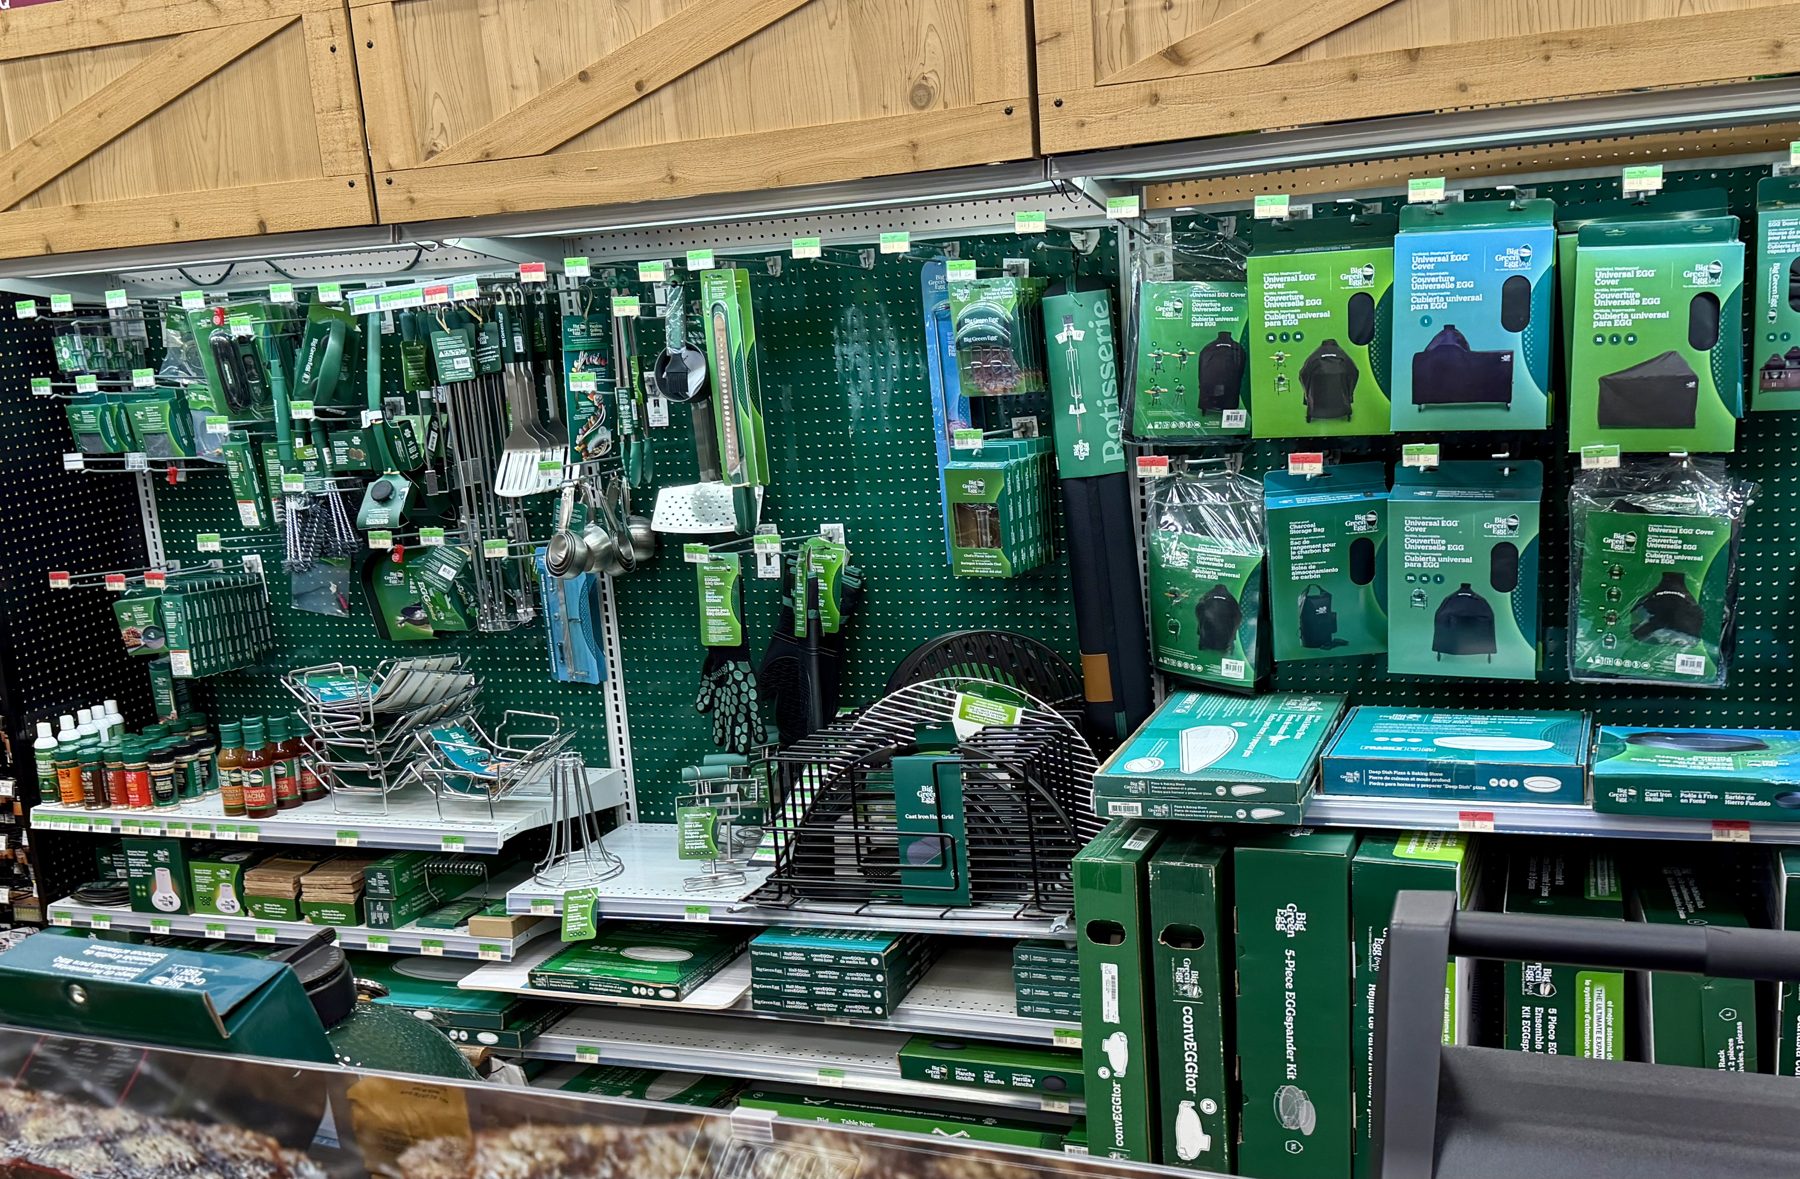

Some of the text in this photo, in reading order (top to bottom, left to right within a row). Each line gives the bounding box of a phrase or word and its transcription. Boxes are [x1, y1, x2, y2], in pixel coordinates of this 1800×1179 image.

[1350, 267, 1363, 276] Big
[1595, 269, 1656, 279] Universal EGG
[1695, 264, 1708, 272] Big
[1411, 295, 1444, 304] Cubierta
[1594, 292, 1640, 300] Couverture
[1594, 297, 1660, 306] Universelle EGG
[1297, 310, 1330, 319] universal
[1593, 311, 1669, 320] Cubierta universal
[1593, 320, 1612, 328] para
[1094, 299, 1125, 464] Rotisserie
[1275, 909, 1287, 932] Egg
[1286, 903, 1297, 938] Green
[1295, 911, 1307, 932] Big
[1183, 957, 1192, 983] Green
[1190, 970, 1199, 984] Big
[1525, 965, 1536, 981] Egg
[1543, 968, 1552, 982] Big
[1284, 948, 1297, 1080] 5-Piece EGGspander Kit
[1522, 1006, 1530, 1018] Kit
[1535, 1007, 1544, 1050] Ensemble
[1548, 1016, 1557, 1040] Piece
[1182, 1005, 1198, 1096] convEGGtor
[1114, 1079, 1124, 1147] convEGGtor
[840, 1118, 857, 1127] Table
[858, 1120, 876, 1128] Nest
